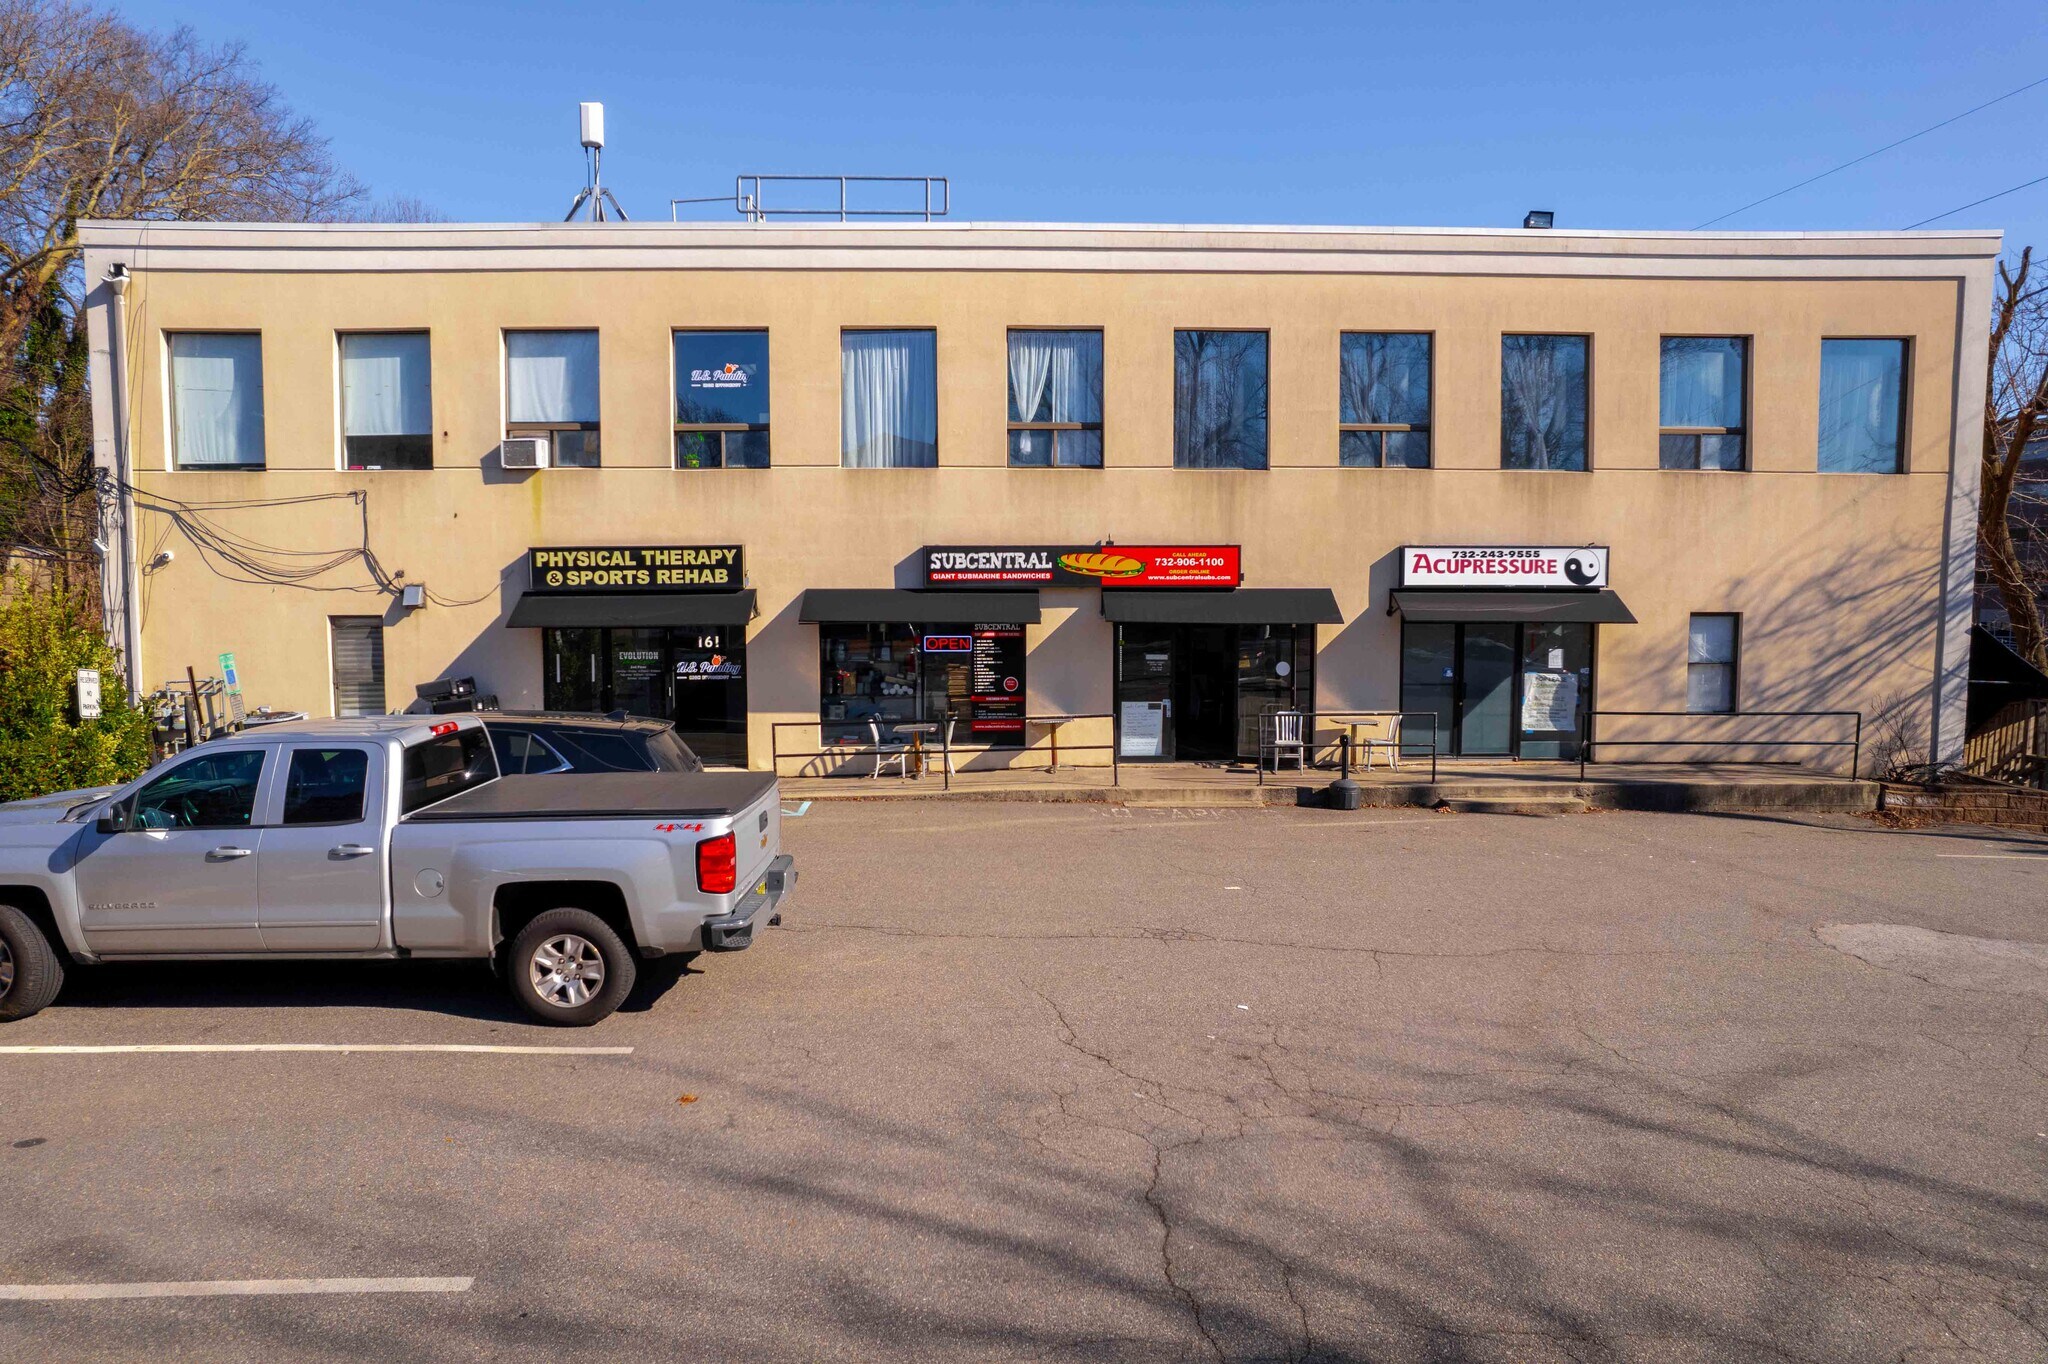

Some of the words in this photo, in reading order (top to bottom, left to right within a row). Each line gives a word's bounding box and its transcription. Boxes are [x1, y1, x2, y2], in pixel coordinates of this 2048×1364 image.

[535, 551, 636, 568] PHYSICAL
[641, 549, 737, 566] THERAPY
[1451, 550, 1541, 559] 732-243-9555
[930, 552, 1053, 569] SUBCENTRAL
[1155, 558, 1224, 567] 732-906-1100
[546, 570, 563, 586] &
[566, 570, 650, 586] SPORTS
[656, 568, 729, 584] REHAB
[932, 572, 956, 580] GIANT
[957, 572, 1001, 580] SUBMARINE
[1002, 571, 1051, 580] SANDWICHES
[974, 623, 1021, 631] SUBCENTRAL
[926, 637, 970, 650] OPEN
[619, 651, 659, 660] EVOLUTION
